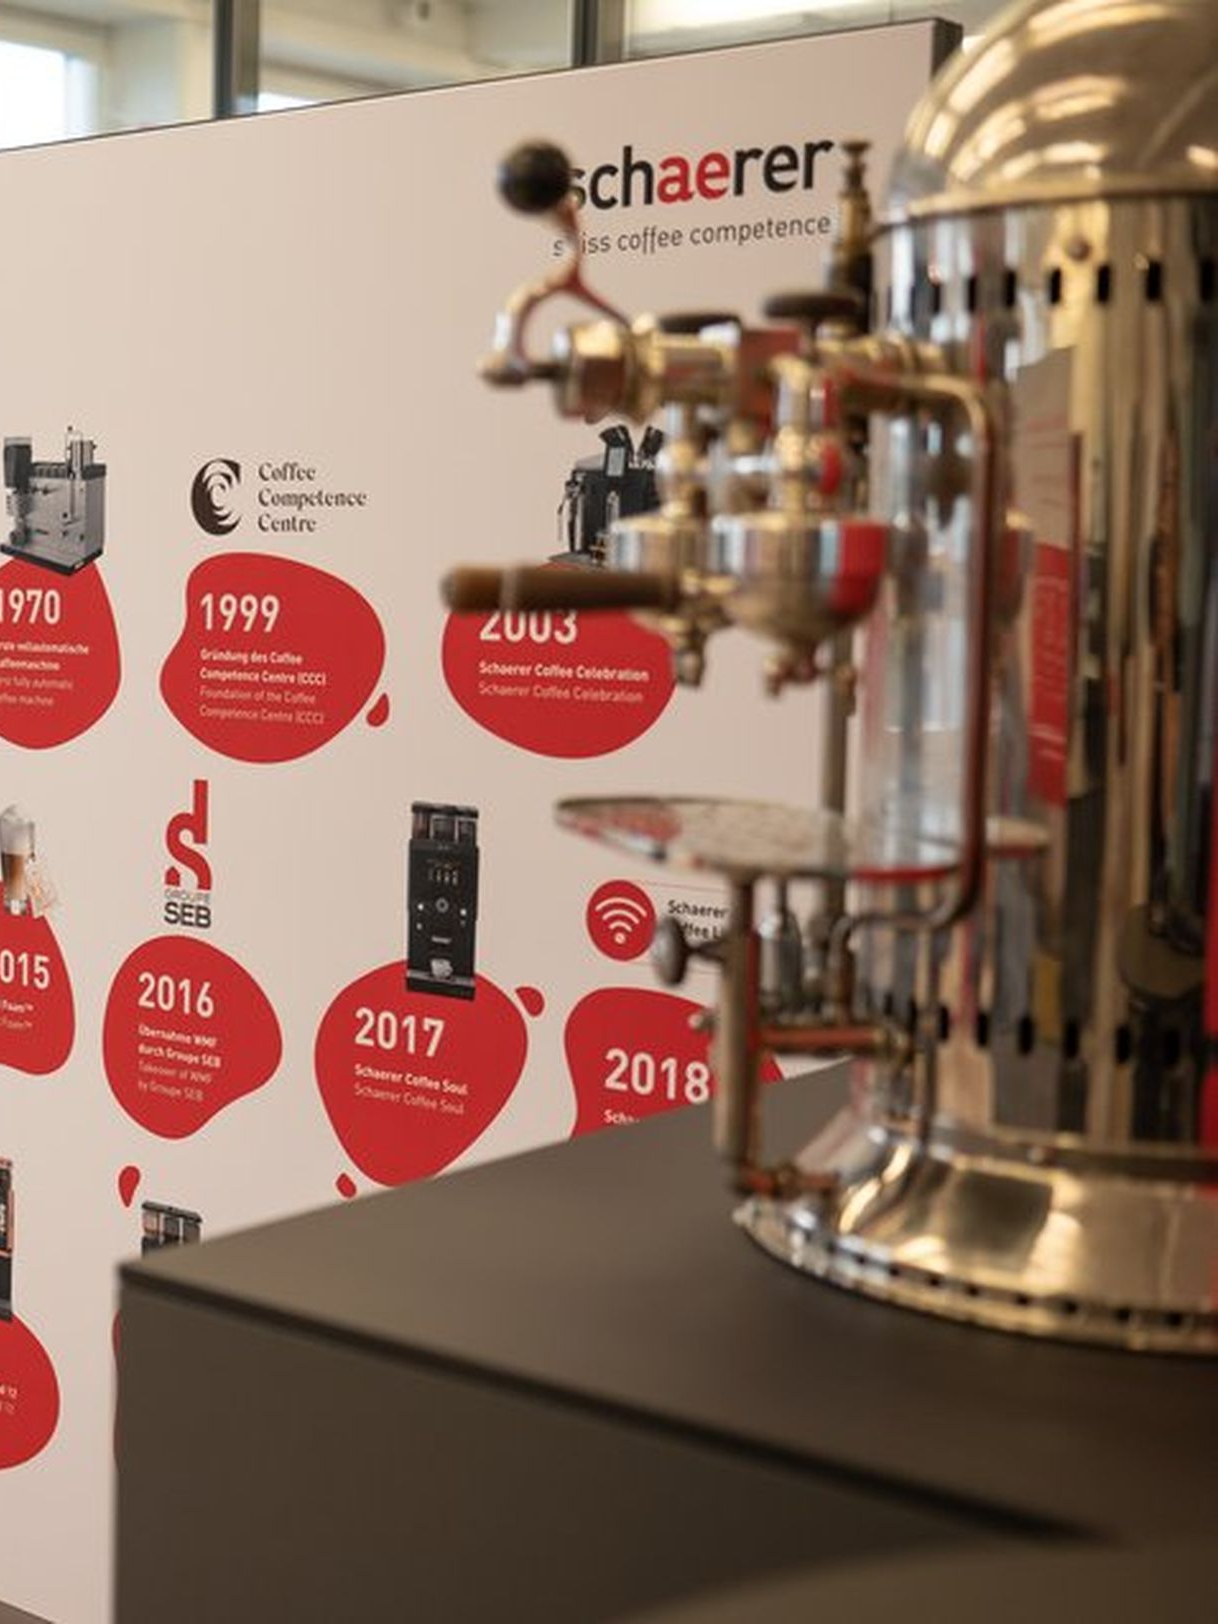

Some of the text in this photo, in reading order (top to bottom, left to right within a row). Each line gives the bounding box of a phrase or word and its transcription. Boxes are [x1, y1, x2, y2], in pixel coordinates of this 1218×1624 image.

[553, 215, 831, 257] siss coffee competence
[258, 462, 316, 481] Coffee
[258, 488, 367, 511] Competence
[258, 514, 316, 532] Centre
[200, 592, 280, 632] 1999
[479, 609, 578, 645] 2003
[201, 648, 303, 665] Gründung des Coffee
[200, 666, 326, 686] Competence Centre (CCC)
[478, 660, 650, 682] Schaerer Coffee Celebration
[200, 685, 316, 704] Foundation of the Coffee
[478, 680, 644, 704] Schaerer Coffee Celebration
[200, 704, 258, 719] Competence
[260, 708, 293, 722] Centre
[164, 901, 211, 929] SEB
[667, 899, 727, 919] Schaerer
[138, 972, 215, 1019] 2016
[138, 1023, 217, 1048] Übernahme WMF
[354, 1006, 446, 1058] 2017
[138, 1043, 221, 1069] durch Groupe SEB
[138, 1060, 177, 1077] Takeover
[354, 1063, 468, 1096] Schaerer Coffee Soul
[604, 1048, 710, 1104] 2018
[184, 1086, 203, 1102] SEB
[354, 1082, 465, 1115] Schaerer Coffee Soul
